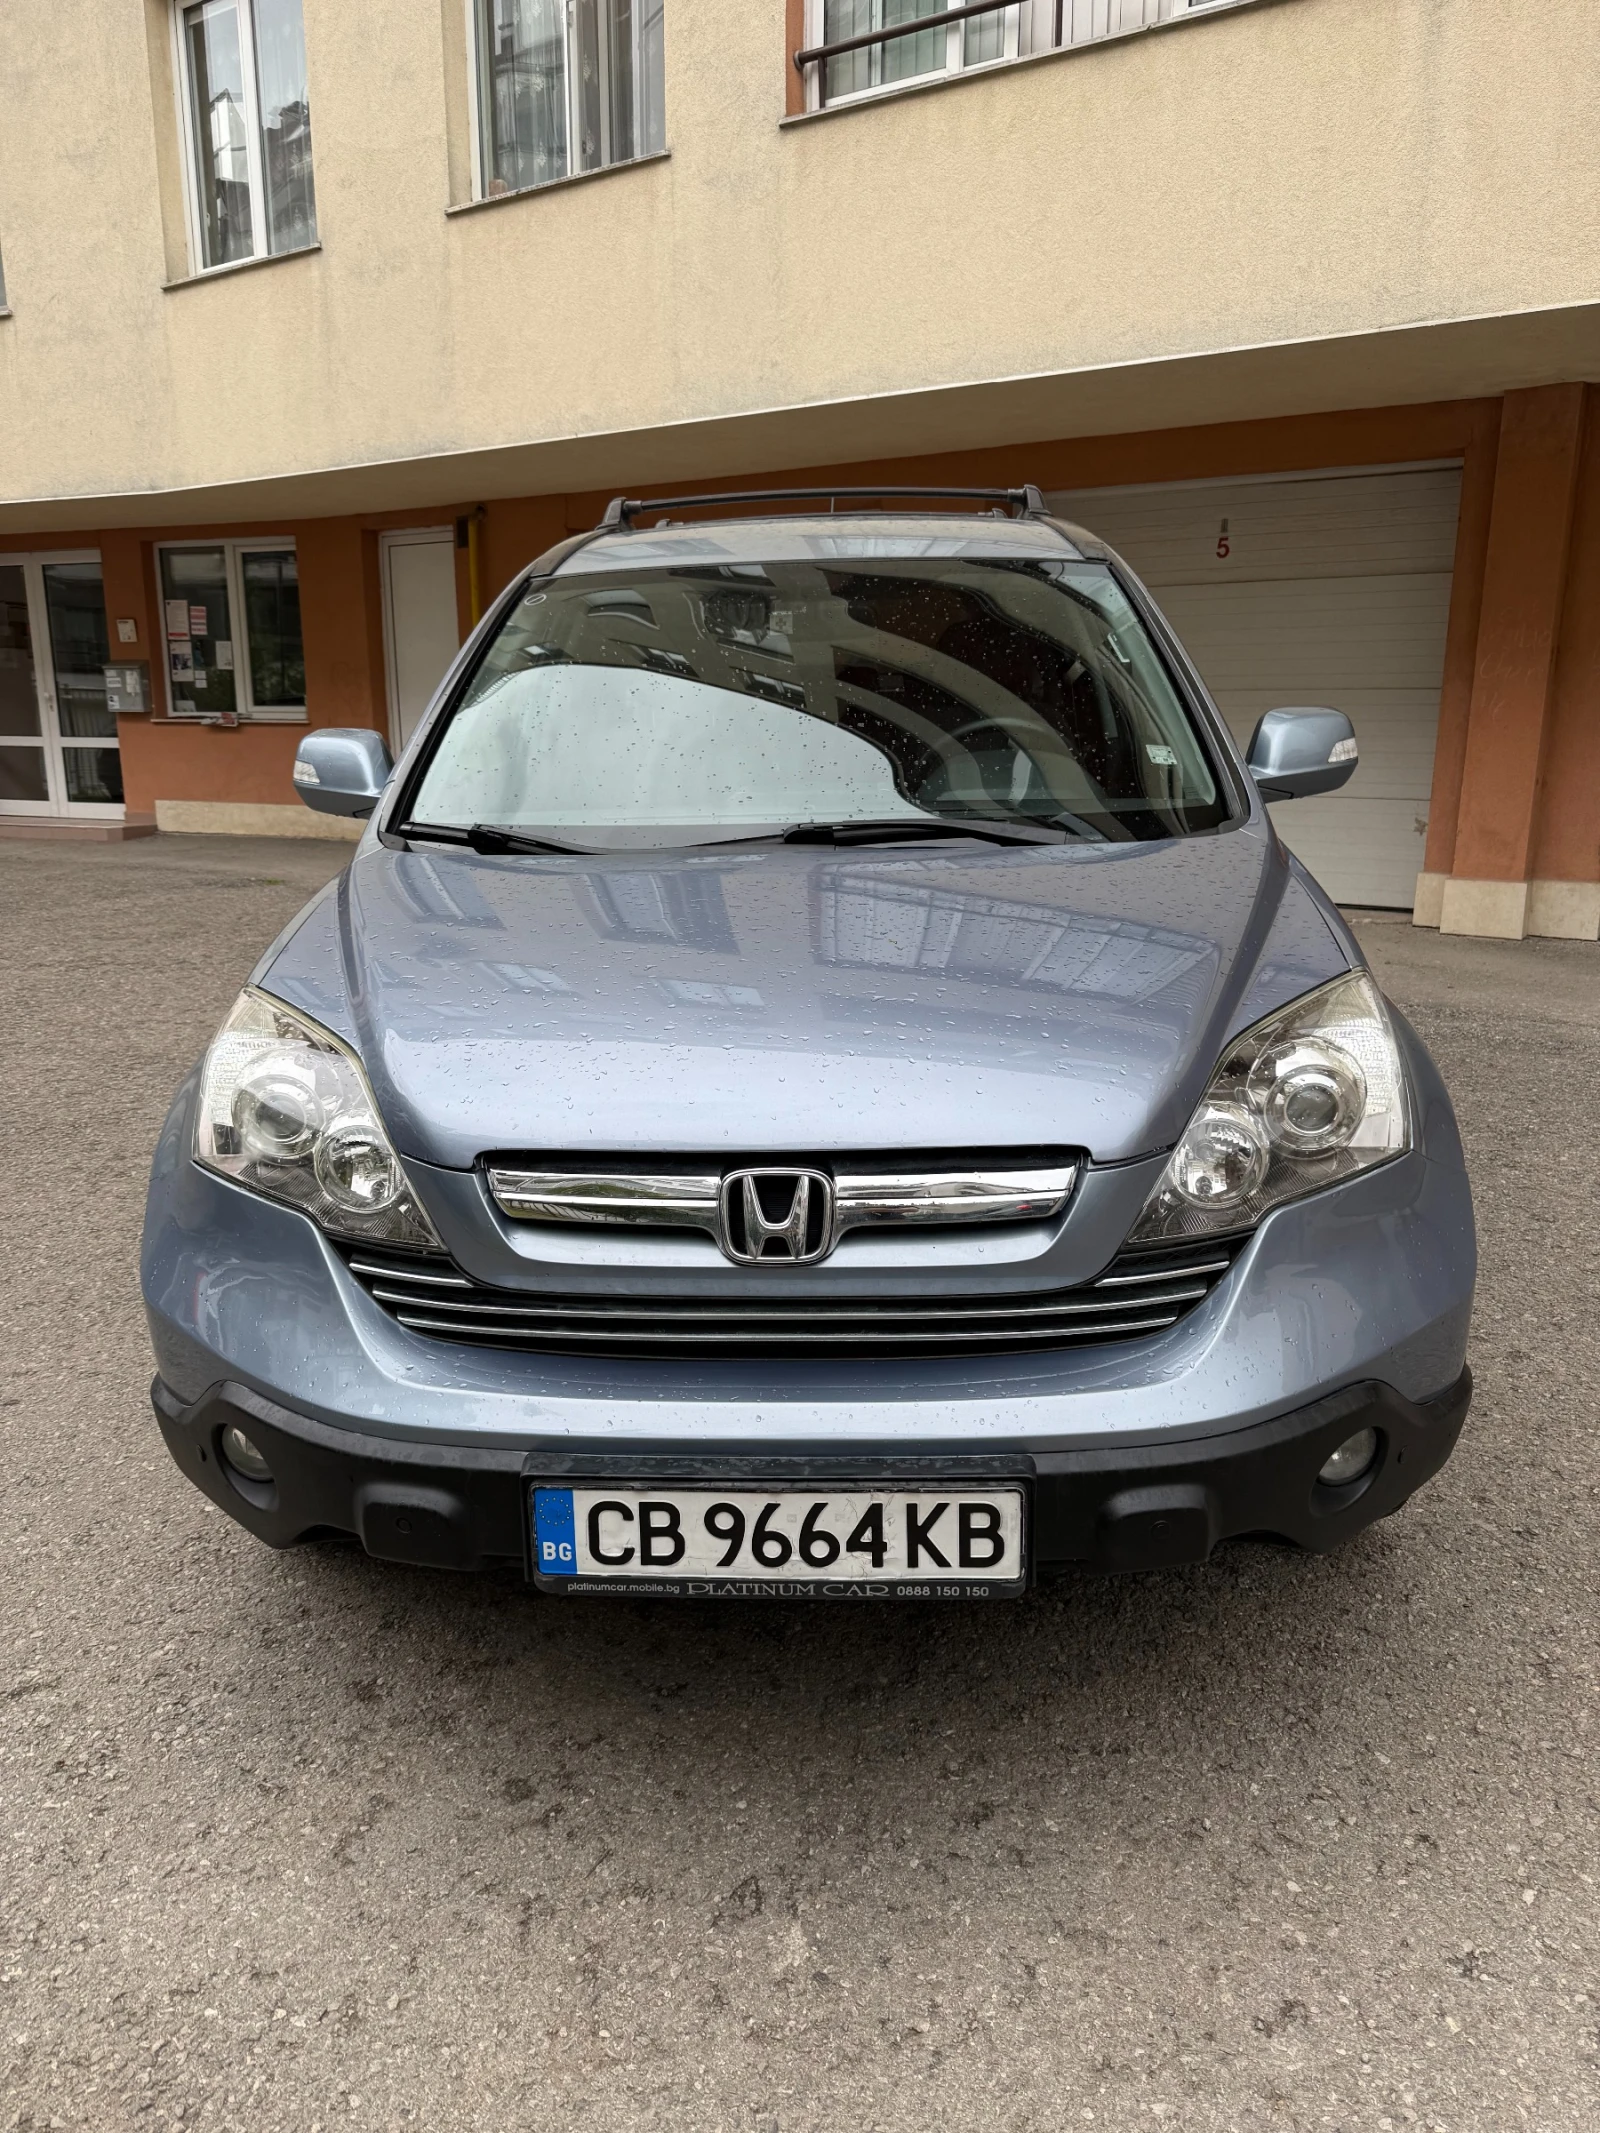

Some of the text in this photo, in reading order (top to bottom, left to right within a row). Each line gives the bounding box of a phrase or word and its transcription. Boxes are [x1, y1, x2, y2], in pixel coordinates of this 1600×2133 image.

[1216, 537, 1230, 559] 5
[588, 1500, 1006, 1569] CB 9664 KB
[542, 1541, 573, 1561] BG
[567, 1582, 989, 1597] platinumcar.mobile.bg PLATINUM CAR 0888 150 150
